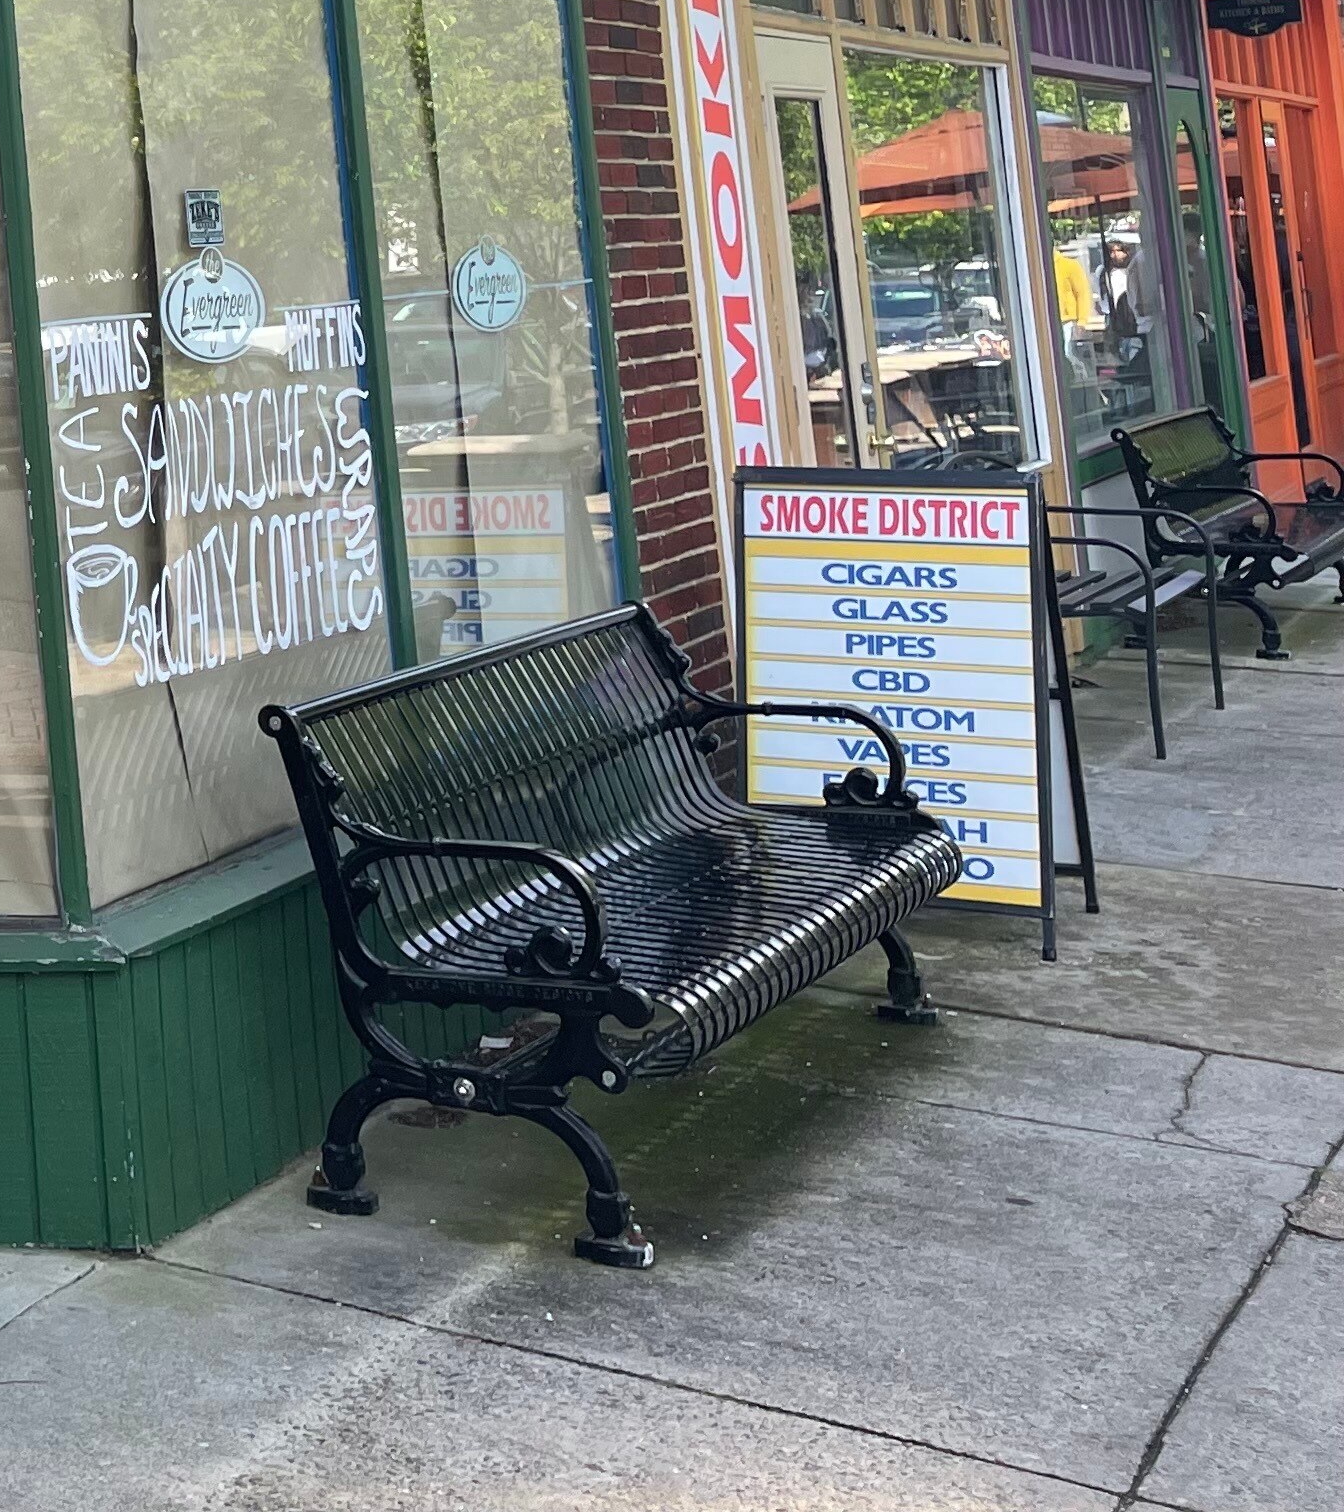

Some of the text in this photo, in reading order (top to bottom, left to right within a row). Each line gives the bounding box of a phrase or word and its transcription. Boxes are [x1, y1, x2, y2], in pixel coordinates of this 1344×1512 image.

[180, 277, 254, 354] Evergreen
[466, 261, 518, 324] Evergreen
[49, 318, 151, 401] PANINIS
[285, 304, 367, 373] MUFFINS
[59, 406, 109, 554] TEA
[113, 384, 337, 529] SANDWICHES
[334, 388, 383, 632] WRAPS
[760, 494, 1021, 541] SMOKE DISTRICT
[131, 507, 350, 688] SPECIALTY COFFEE
[821, 562, 959, 589] CIGARS
[831, 597, 949, 624] GLASS
[845, 632, 937, 658] PIPES
[851, 669, 931, 694] CBD
